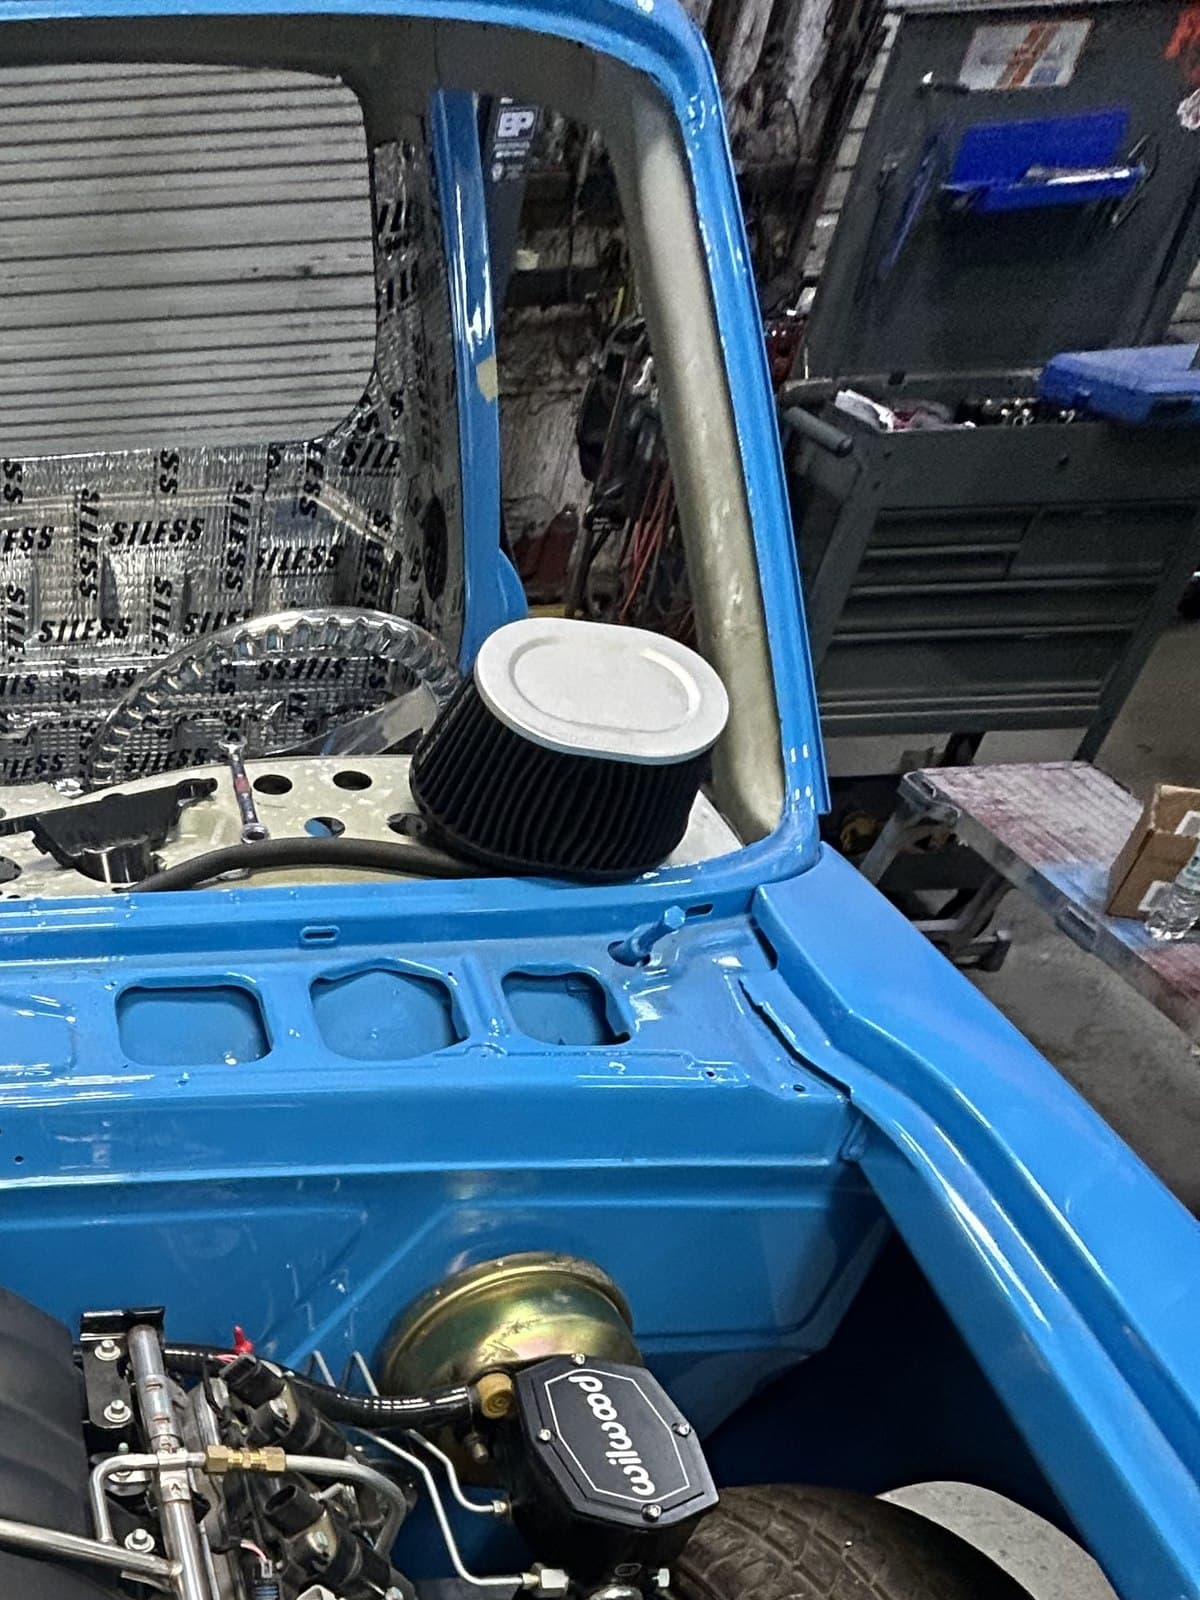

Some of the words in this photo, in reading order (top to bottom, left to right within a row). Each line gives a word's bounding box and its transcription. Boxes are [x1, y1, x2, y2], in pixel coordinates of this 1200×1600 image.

[78, 487, 100, 601] SILESS
[109, 517, 205, 547] SILESS
[225, 480, 254, 594] SILESS
[38, 617, 132, 644] SILESS
[567, 1374, 657, 1497] wilwood
